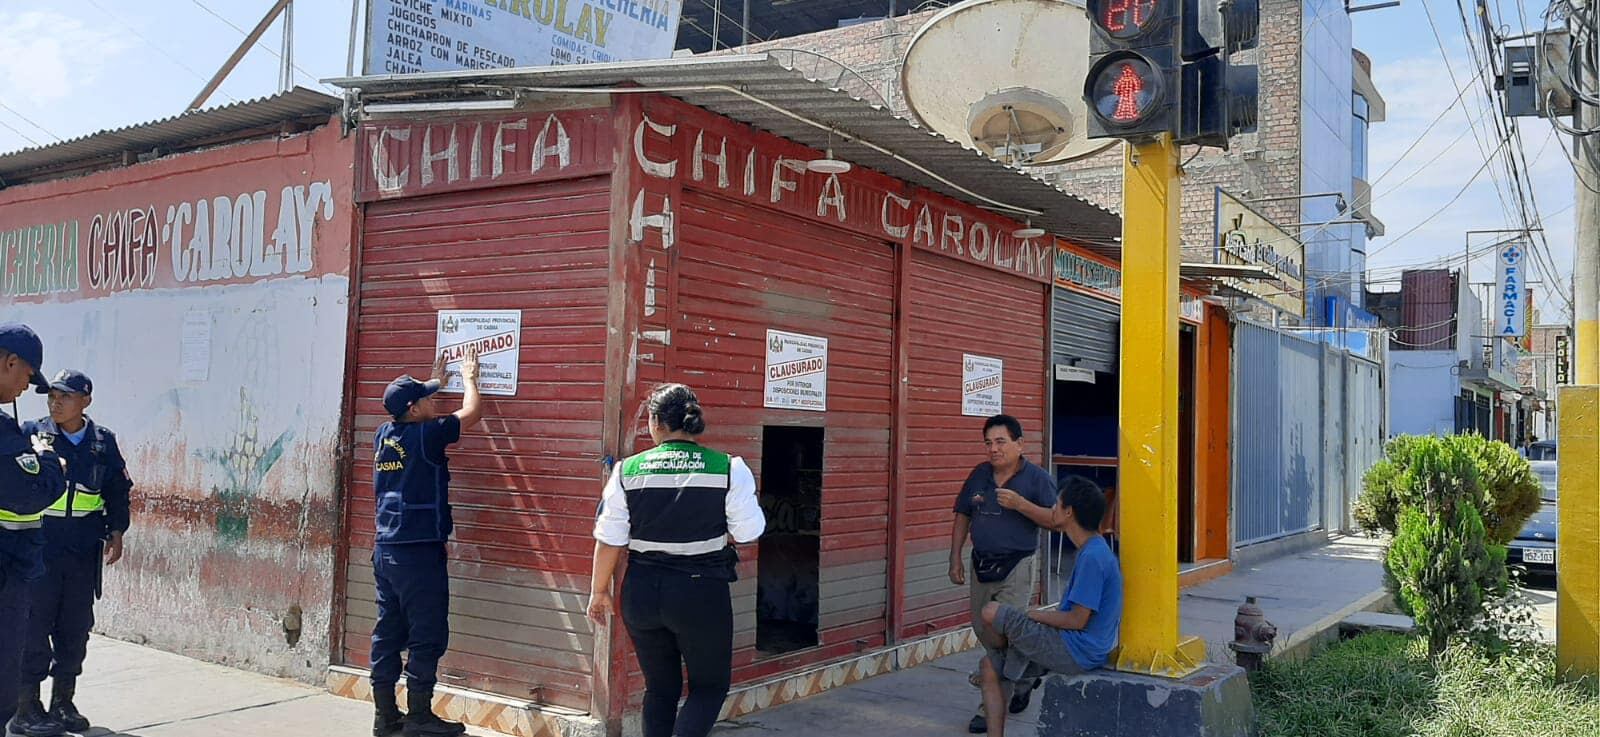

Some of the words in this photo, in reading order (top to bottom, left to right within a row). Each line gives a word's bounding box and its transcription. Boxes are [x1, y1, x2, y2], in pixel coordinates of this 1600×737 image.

[389, 6, 436, 29] JUGOSOS
[441, 8, 472, 27] MIXTO
[387, 33, 422, 53] ARROZ
[431, 46, 448, 61] CON
[388, 19, 451, 48] CHICHARRON
[457, 41, 468, 54] DE
[474, 46, 515, 68] PESCADO
[551, 46, 571, 62] LOMO
[552, 34, 586, 55] COMIDAS
[386, 47, 422, 67] JALEA
[371, 113, 571, 191] CHIFA
[88, 203, 159, 290] CHIFA
[881, 191, 1051, 277] CAROLAY
[1502, 267, 1518, 334] FARMACIA
[770, 359, 822, 379] CLAUSURADO
